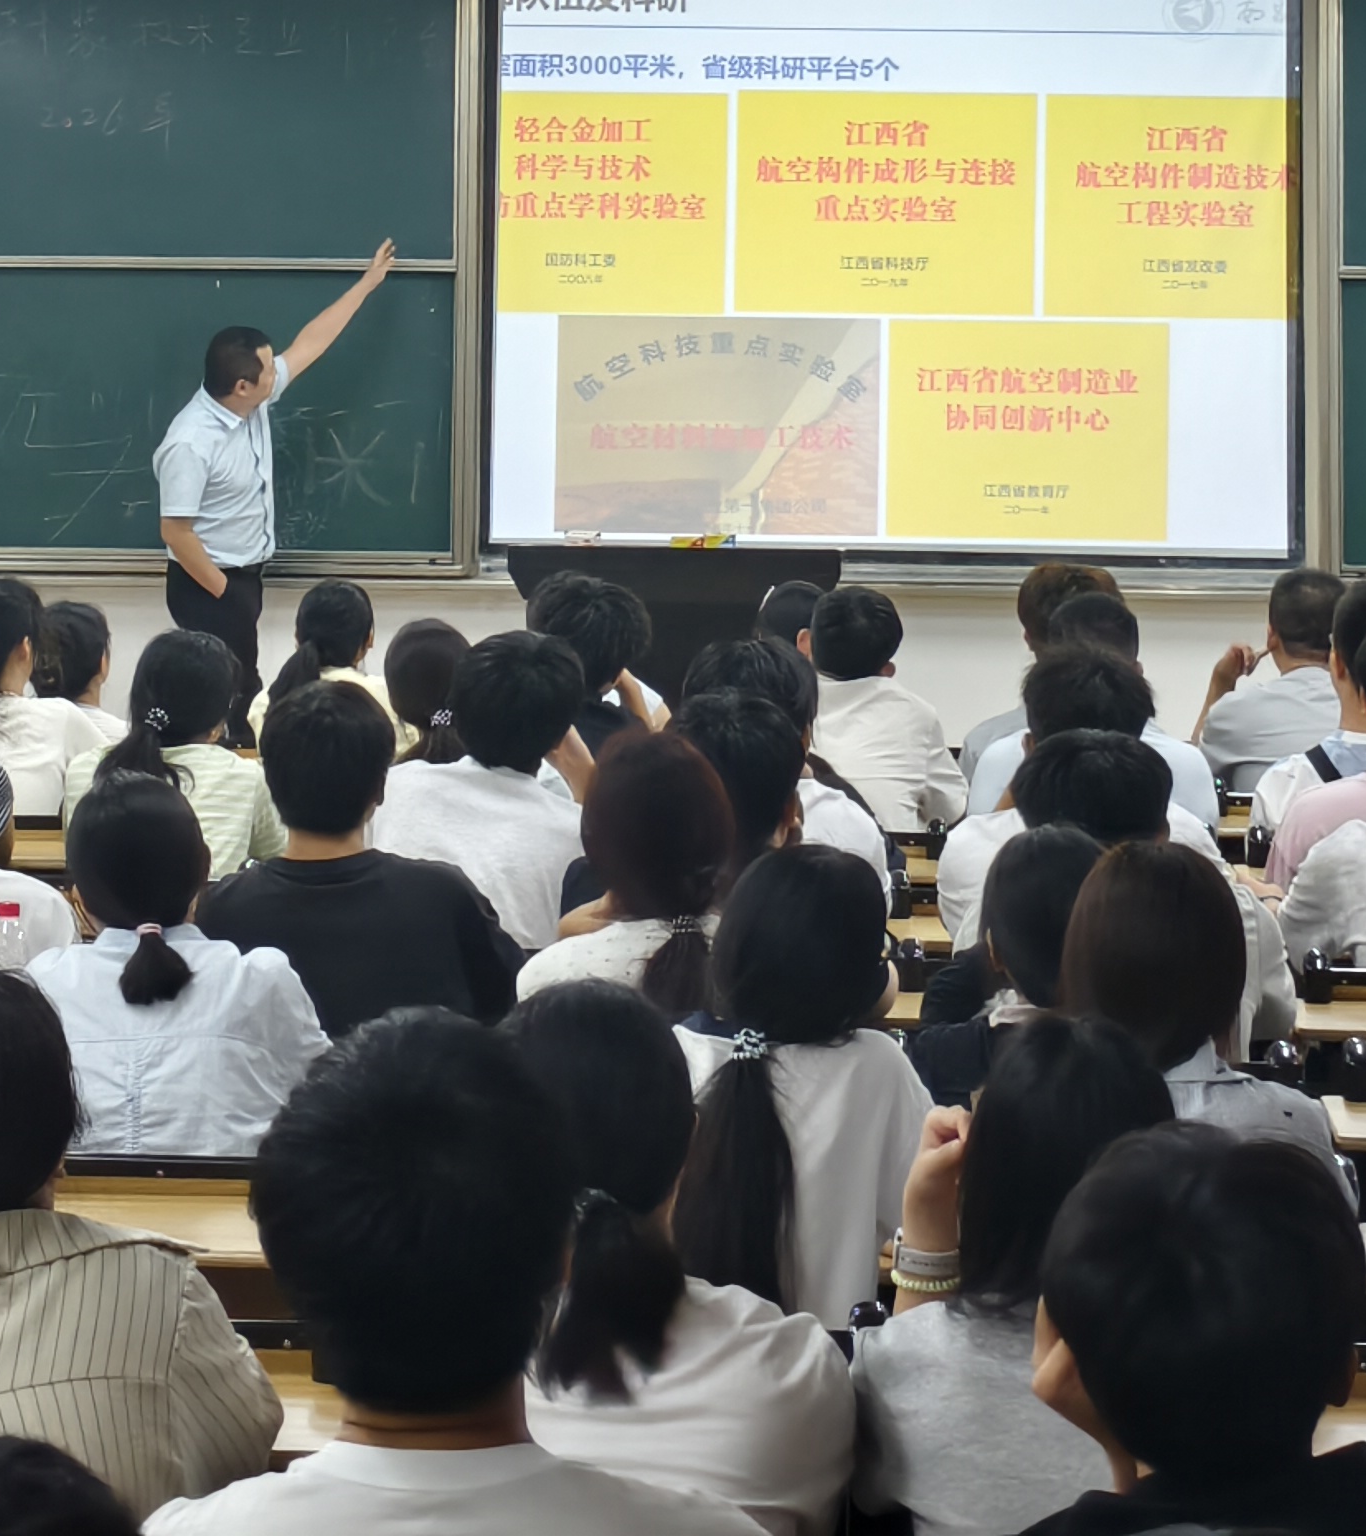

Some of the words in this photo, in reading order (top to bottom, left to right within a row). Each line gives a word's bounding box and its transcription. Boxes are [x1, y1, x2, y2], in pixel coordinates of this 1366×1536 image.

[514, 116, 652, 143] 轻合金加工
[844, 120, 930, 147] 江西省
[1146, 125, 1228, 152] 江西省
[514, 153, 652, 182] 科学与技术
[756, 156, 1017, 186] 航空构件成形与连接
[815, 194, 957, 222] 重点实验室
[1116, 200, 1255, 227] 工程实验室
[545, 252, 616, 268] 国防科工委
[839, 255, 929, 271] 江西省科技厅
[1142, 259, 1228, 274] 江西省发改委
[573, 331, 867, 403] 航空科技重点实验室
[916, 366, 1139, 395] 江西省航空制造业
[945, 403, 1110, 432] 协同创新中心
[983, 484, 1069, 499] 江西省教育厅
